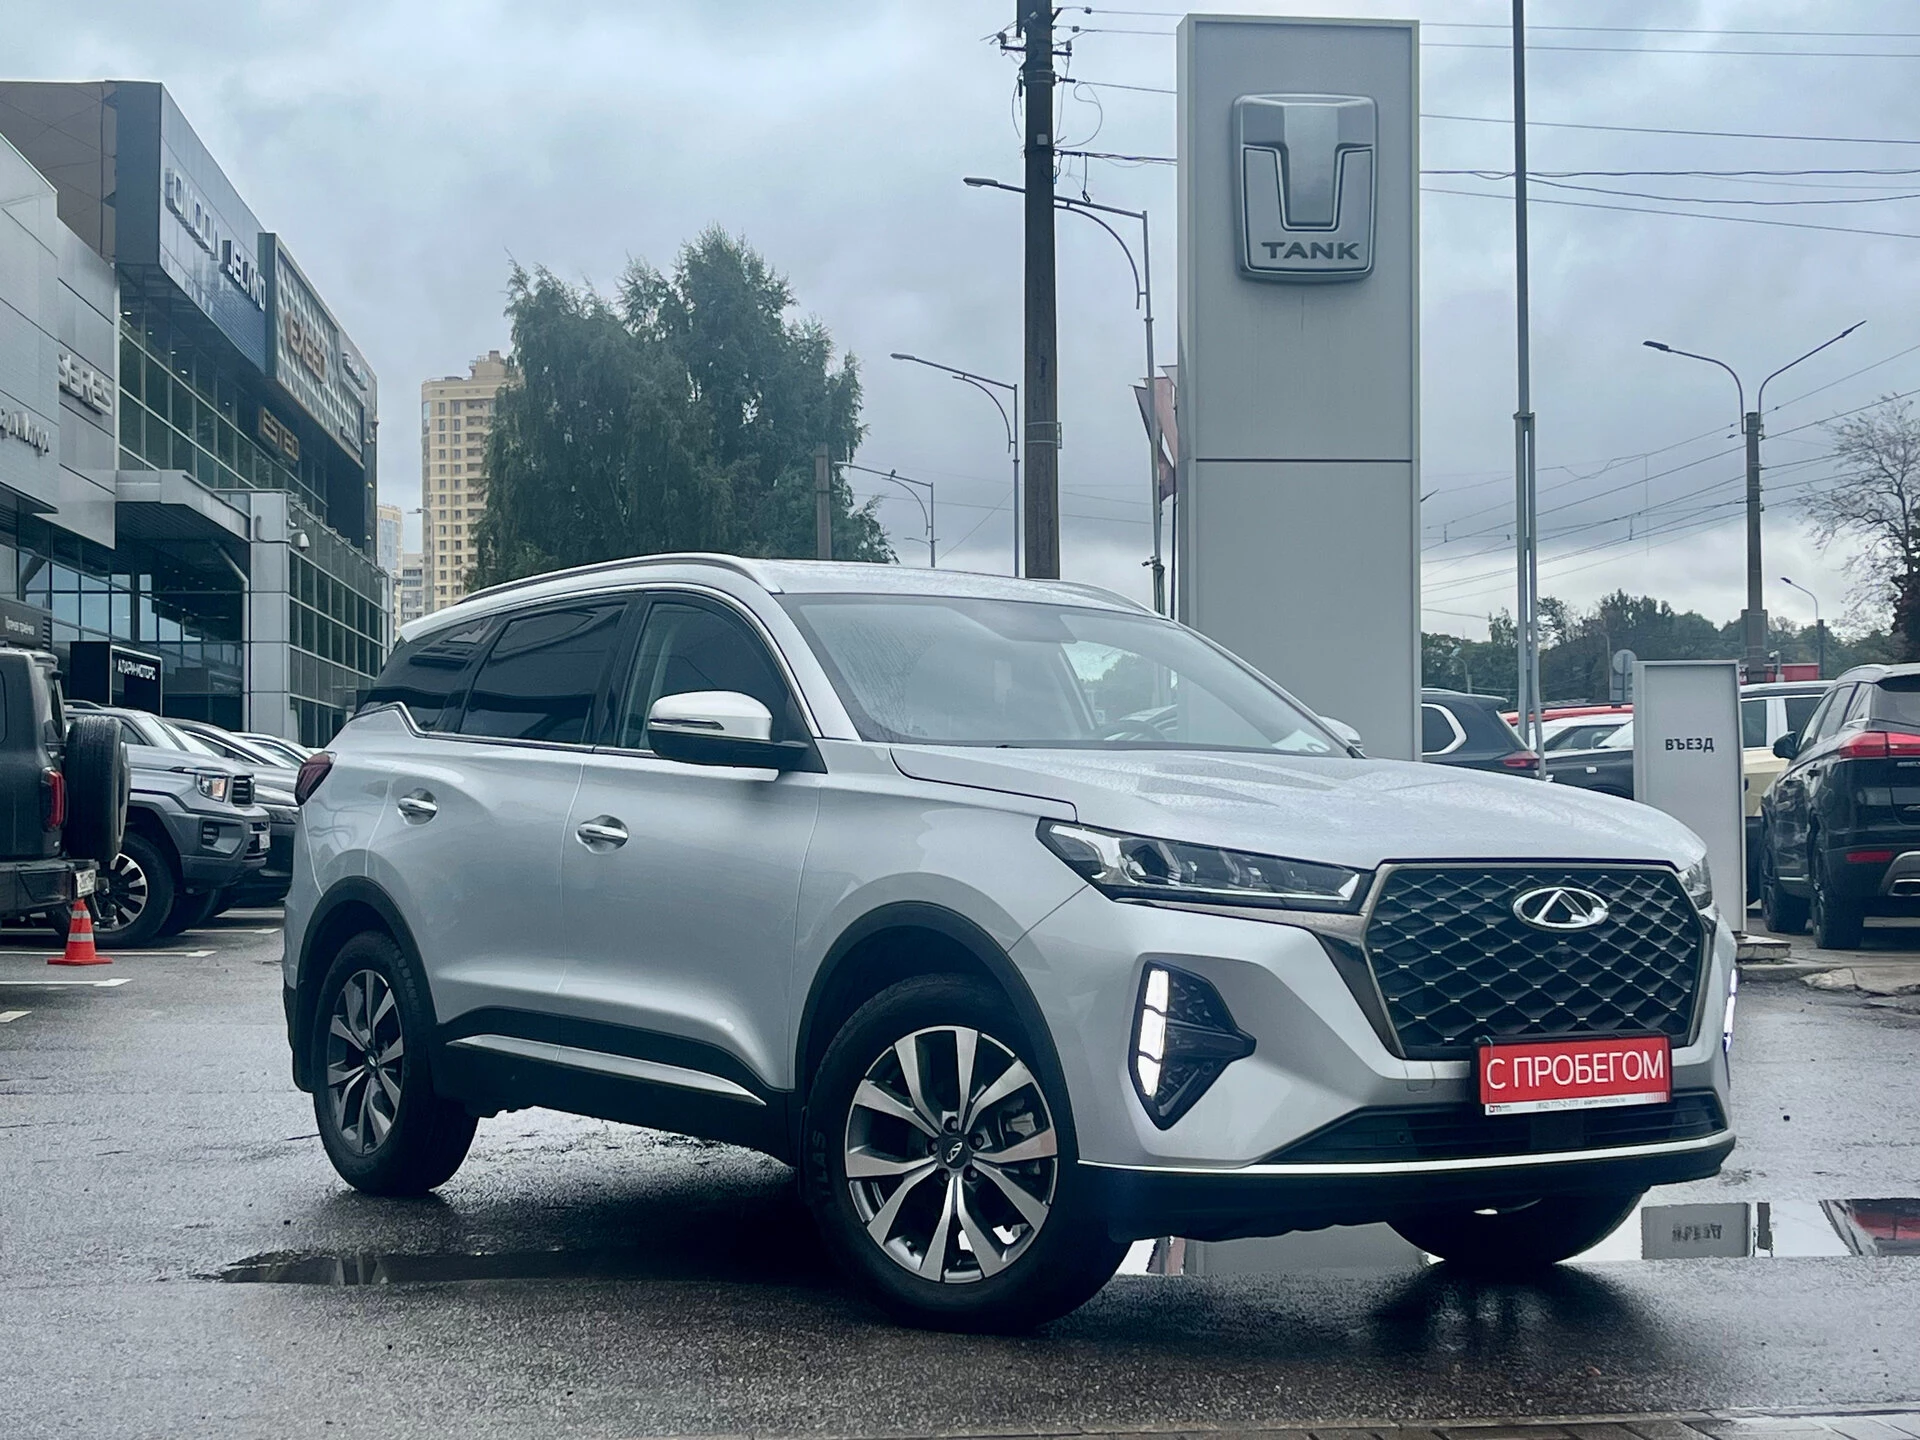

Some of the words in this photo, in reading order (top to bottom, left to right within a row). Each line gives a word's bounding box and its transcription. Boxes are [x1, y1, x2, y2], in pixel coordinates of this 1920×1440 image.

[1261, 241, 1360, 260] TANK
[286, 312, 328, 384] EXEED
[58, 354, 113, 417] SERES
[1665, 737, 1714, 753] ВЪЕЗД
[1486, 1058, 1506, 1089] С
[1513, 1049, 1664, 1088] ПРОБЕГОМ
